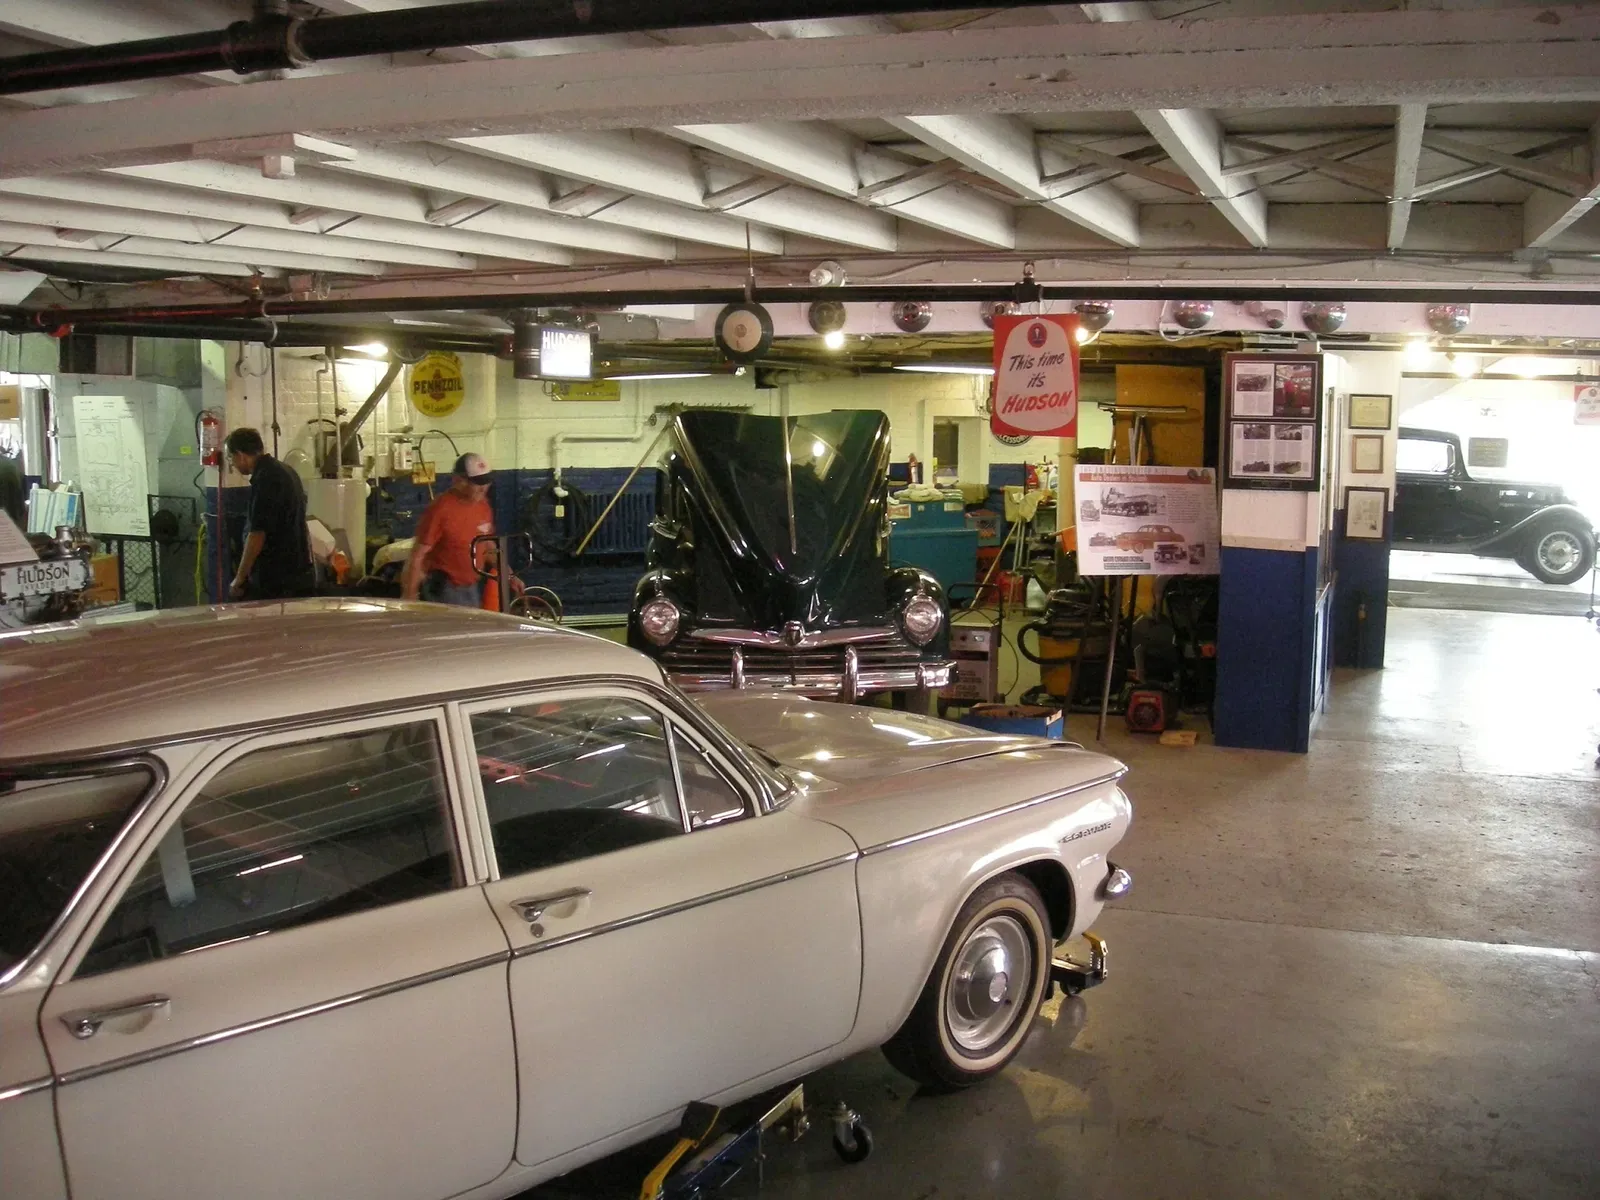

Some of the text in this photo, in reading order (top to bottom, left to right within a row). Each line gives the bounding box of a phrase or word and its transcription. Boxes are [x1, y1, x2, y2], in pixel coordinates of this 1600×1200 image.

[1009, 351, 1065, 371] This time
[1027, 372, 1046, 388] it's
[1002, 390, 1073, 414] HUDSON
[17, 565, 70, 584] HUDSON
